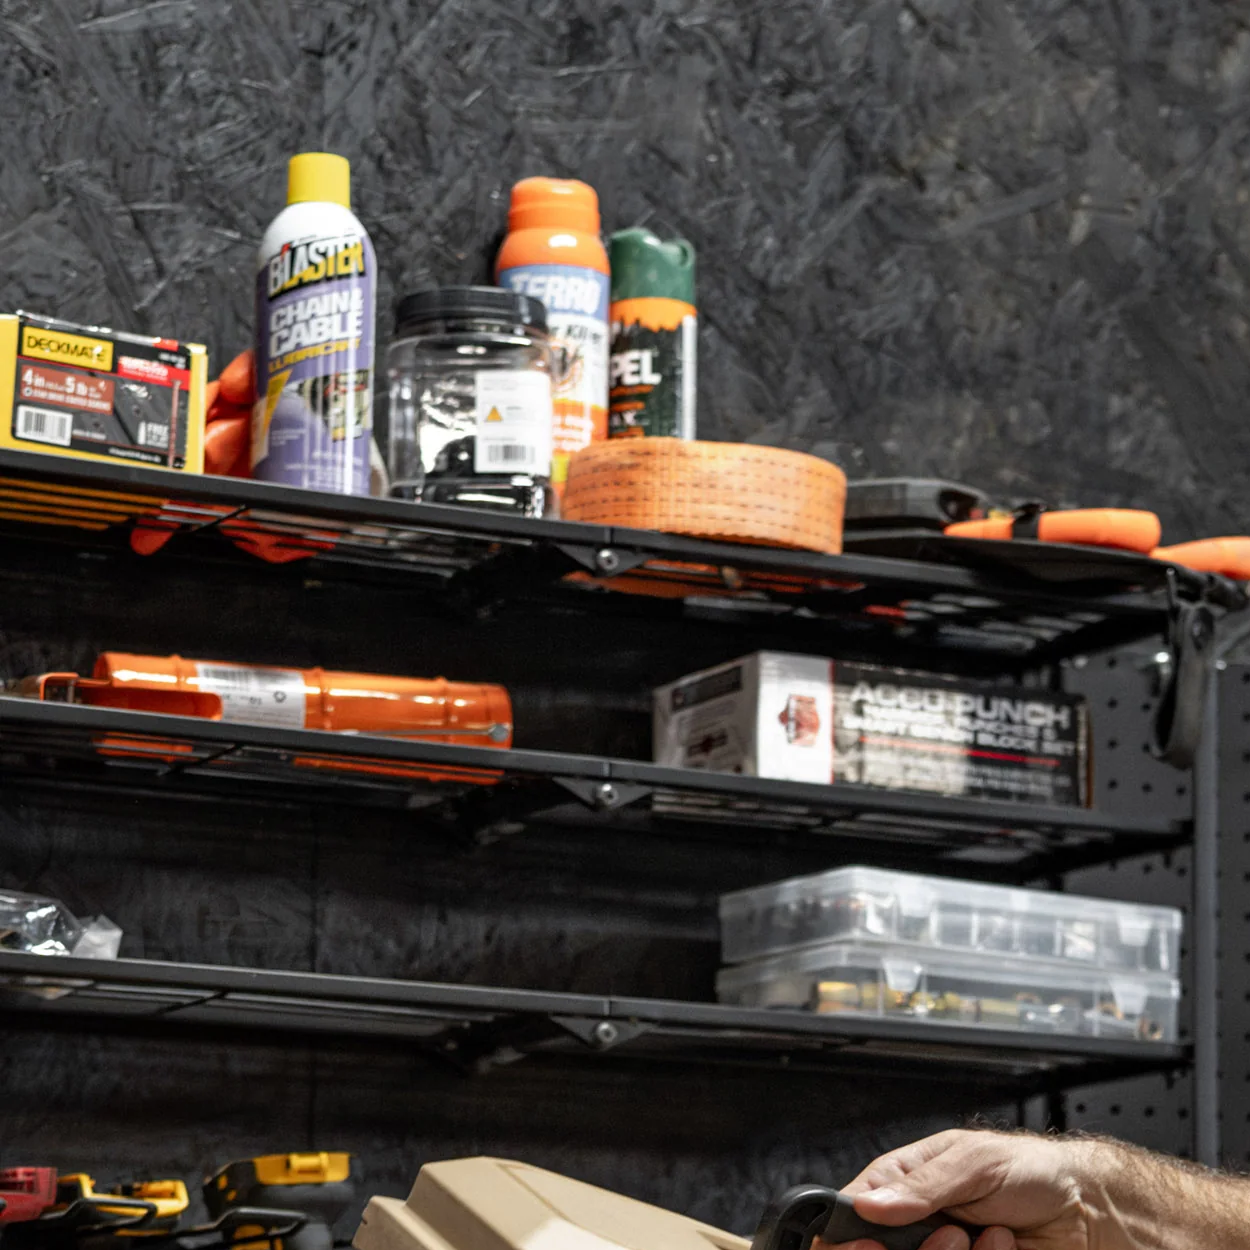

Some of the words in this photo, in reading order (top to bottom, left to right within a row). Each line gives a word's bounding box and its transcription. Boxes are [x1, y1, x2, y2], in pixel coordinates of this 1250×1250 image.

[271, 290, 350, 333] CHAIN
[27, 336, 105, 361] DECKMATE
[269, 310, 363, 358] CABLE
[610, 350, 662, 386] PEL
